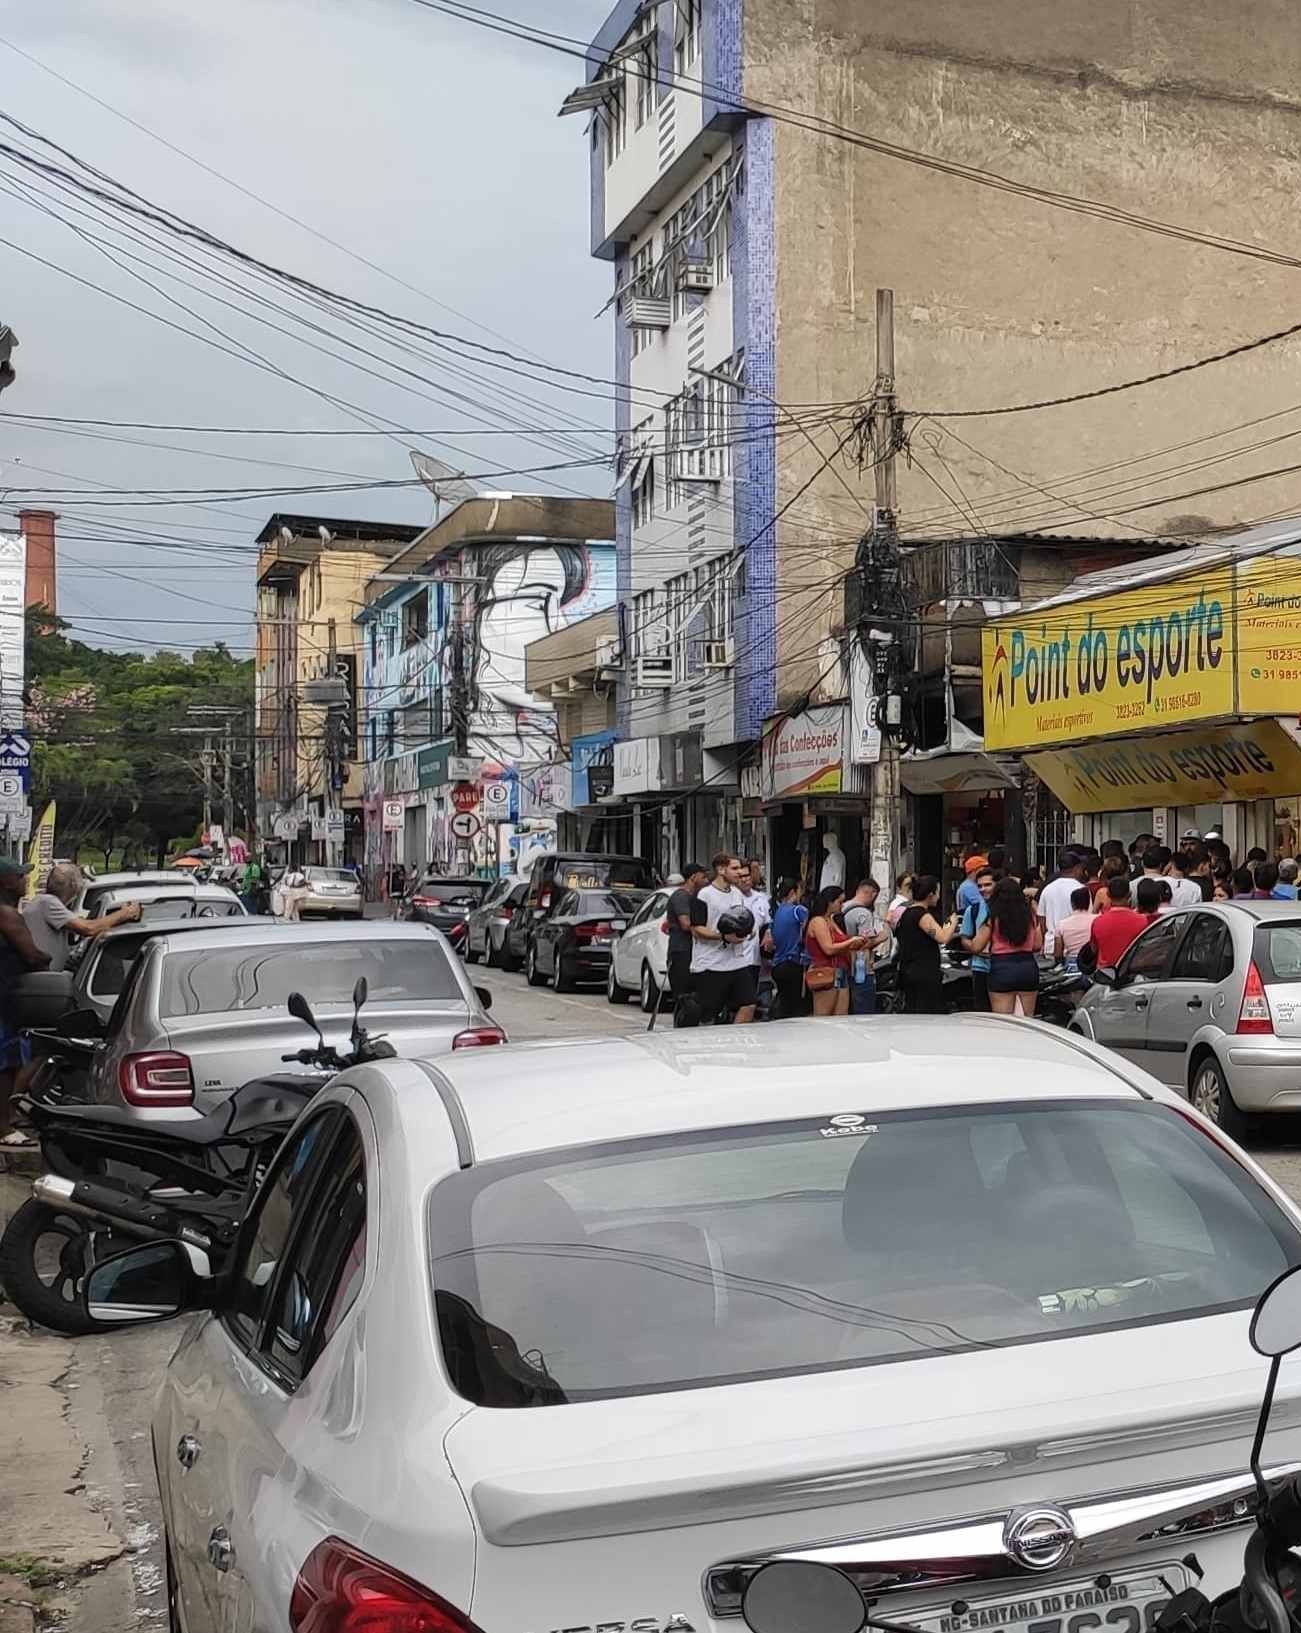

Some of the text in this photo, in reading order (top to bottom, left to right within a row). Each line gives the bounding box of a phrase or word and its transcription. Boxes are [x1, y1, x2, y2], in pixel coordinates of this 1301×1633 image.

[1257, 592, 1285, 609] Point
[1287, 594, 1300, 609] do
[1010, 588, 1223, 708] Point do esporte
[1263, 670, 1275, 679] 31
[1172, 737, 1275, 789] esporte
[493, 789, 501, 800] E
[1042, 1598, 1061, 1615] DO
